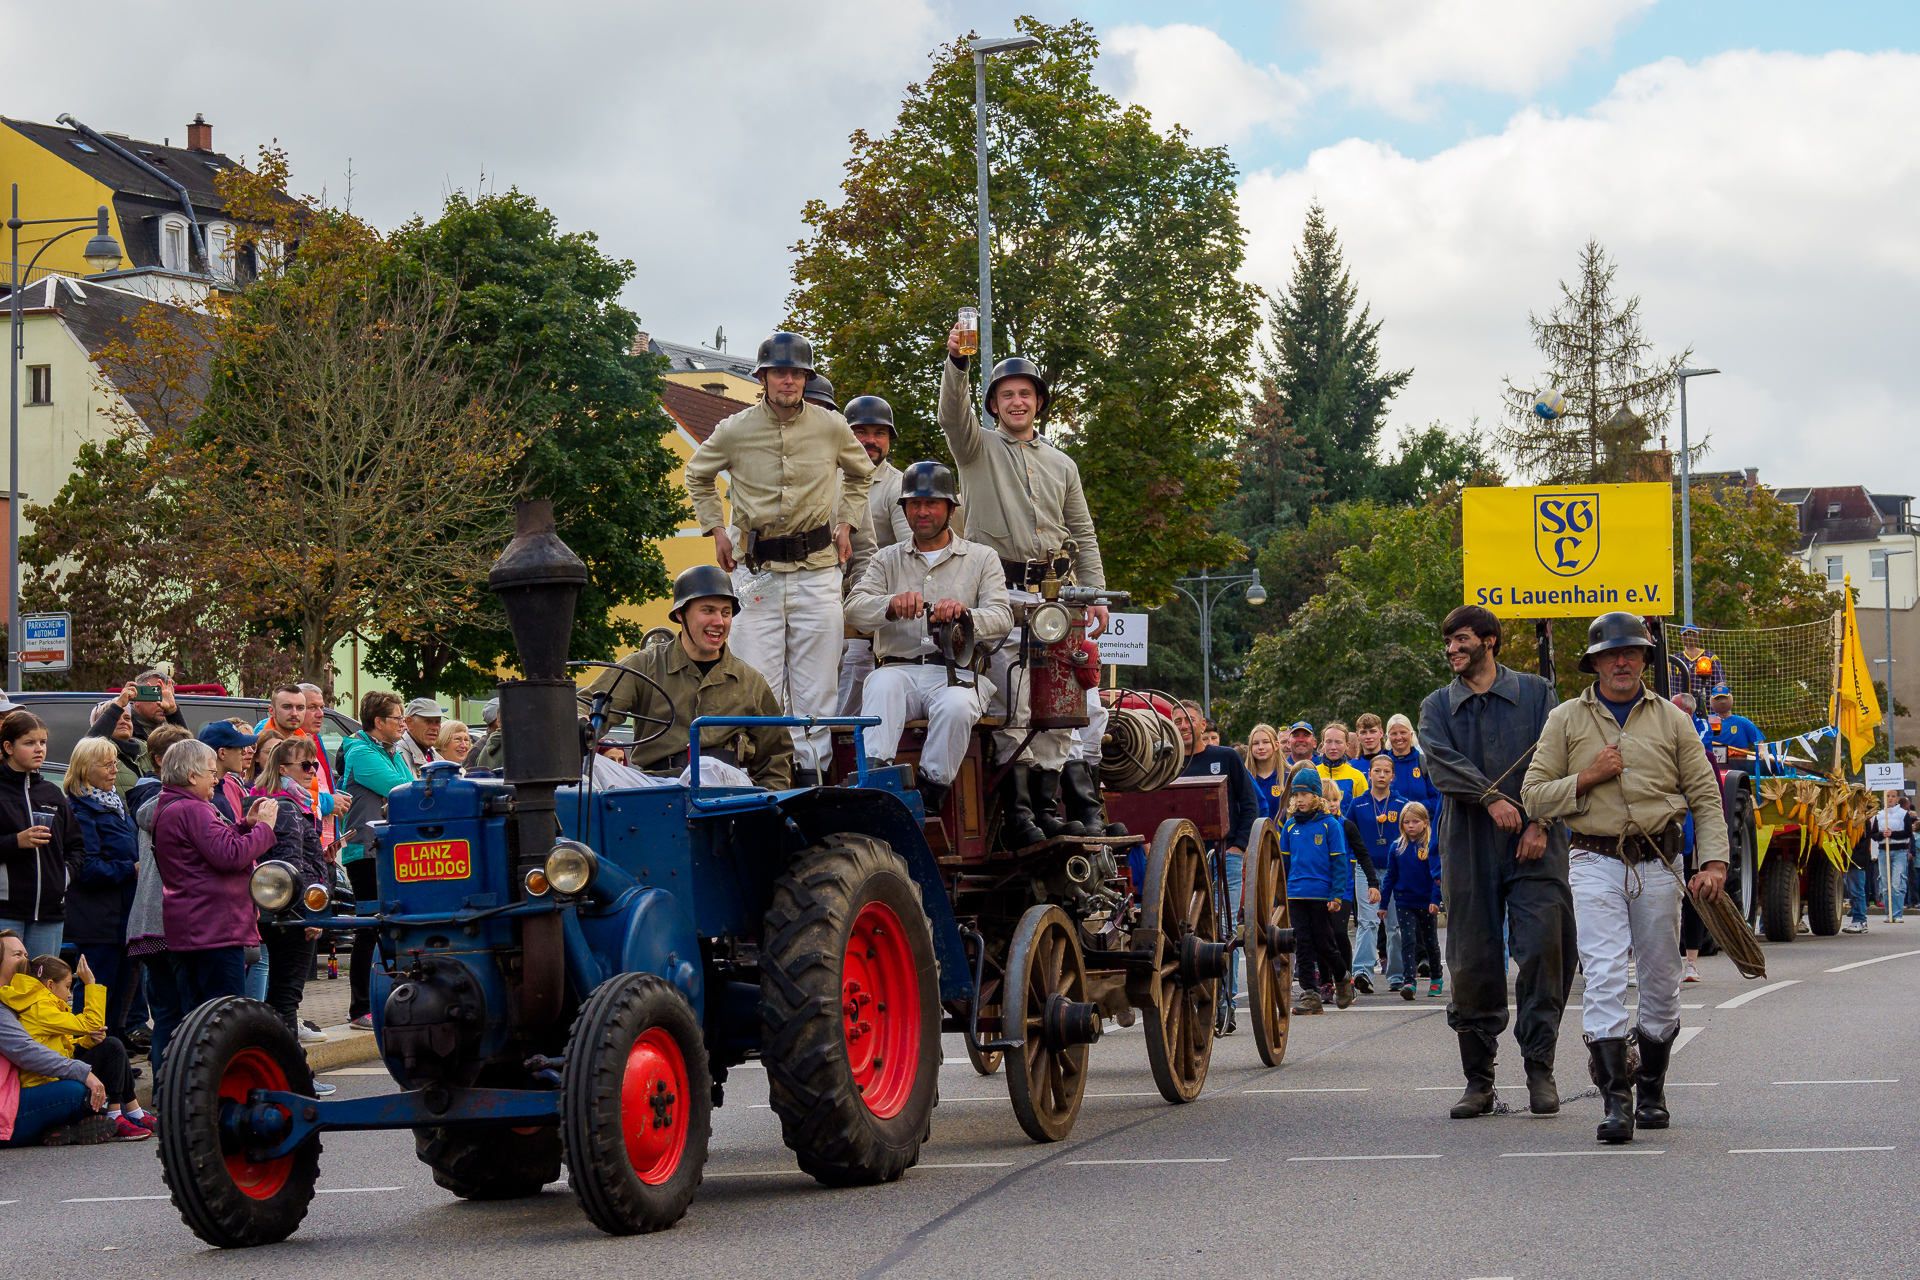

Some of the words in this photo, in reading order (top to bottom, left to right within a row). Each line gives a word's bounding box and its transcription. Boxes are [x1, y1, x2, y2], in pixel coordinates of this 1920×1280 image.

[1539, 500, 1594, 534] SG
[1554, 536, 1583, 569] L
[1476, 587, 1503, 606] SG
[1511, 584, 1618, 605] Lauenhain
[1625, 584, 1661, 603] e.V.
[27, 620, 64, 630] PARKSCHEIN-
[33, 629, 59, 638] AUTOMAT
[1097, 641, 1144, 649] gemeinschaft
[1878, 766, 1892, 776] 19
[410, 844, 452, 861] LANZ
[399, 860, 467, 878] BULLDOG
